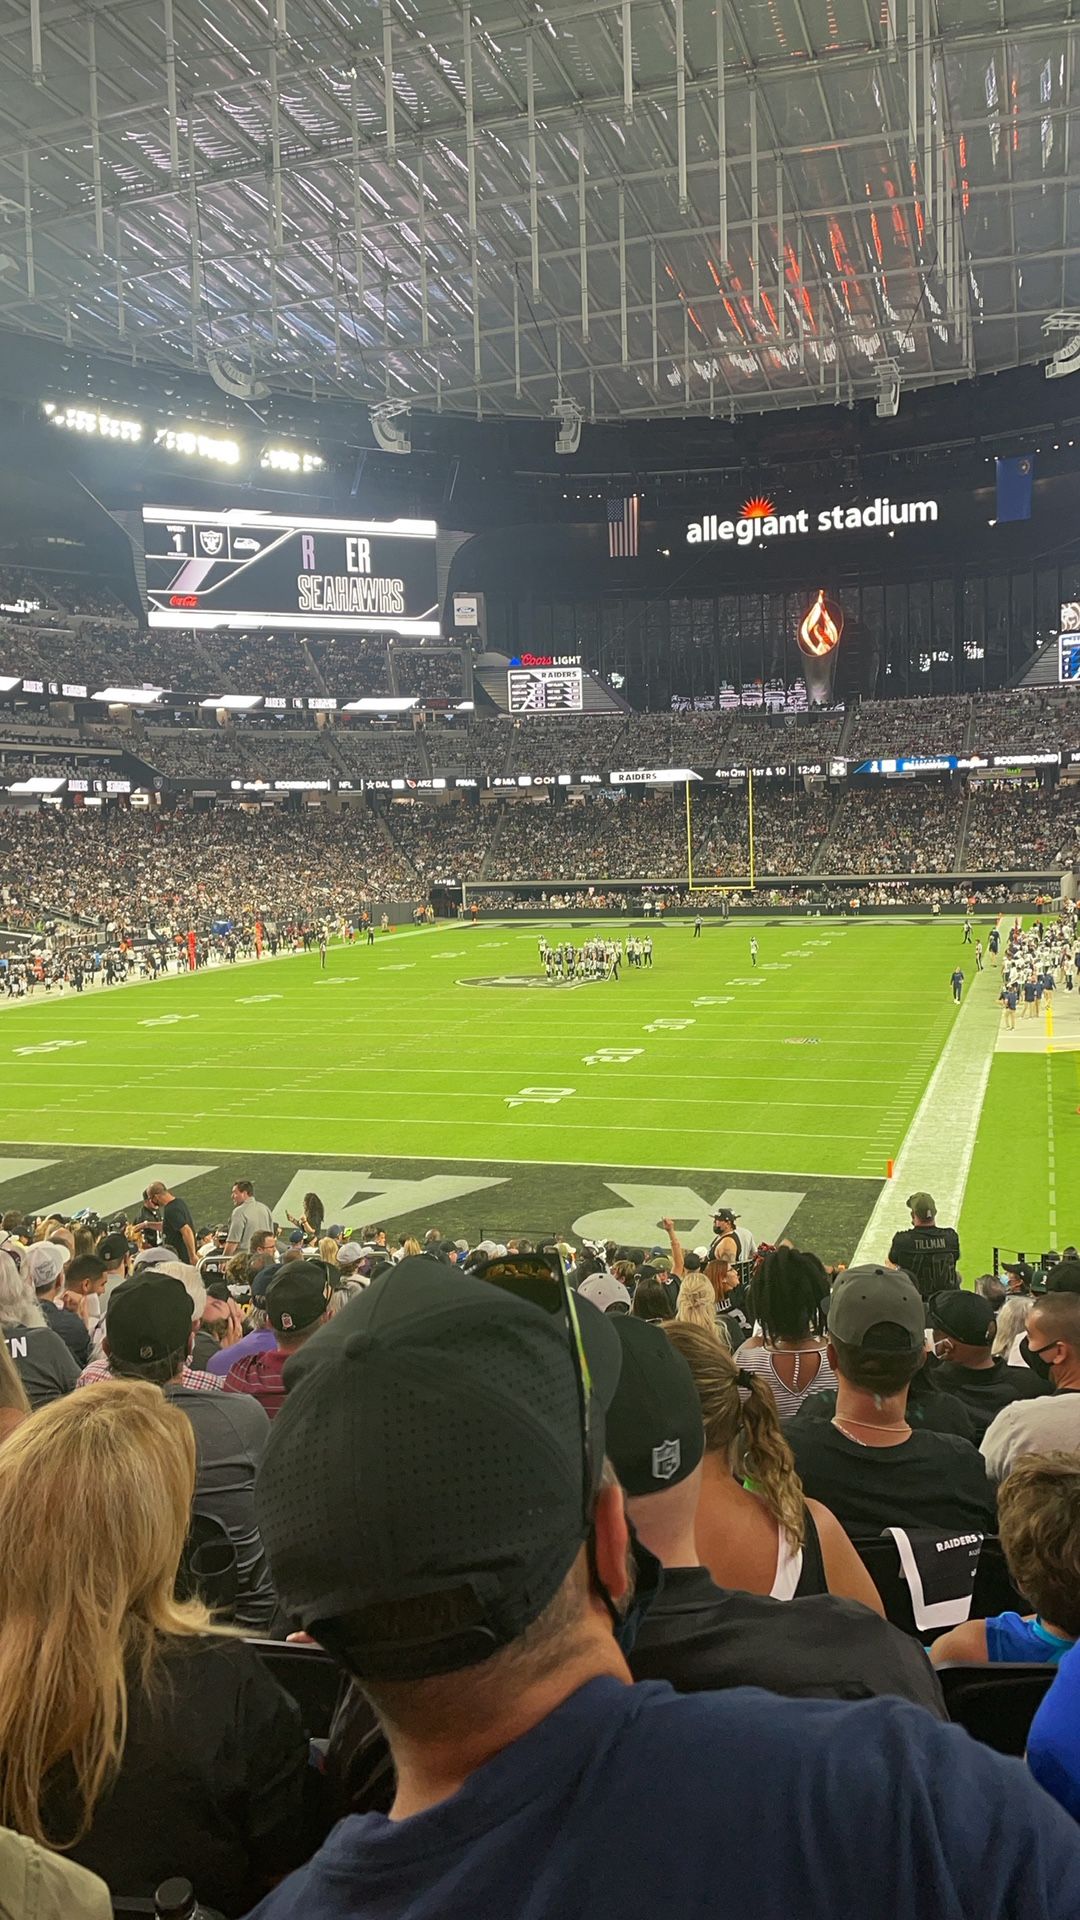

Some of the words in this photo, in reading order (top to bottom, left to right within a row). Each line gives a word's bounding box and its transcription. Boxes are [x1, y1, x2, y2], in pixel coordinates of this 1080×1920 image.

[686, 509, 809, 545] allegiant
[817, 498, 938, 530] stadium
[172, 533, 182, 552] 1
[298, 575, 404, 614] SEAHAWKS
[521, 654, 552, 666] Coors
[553, 655, 581, 665] LIGHT
[541, 670, 578, 679] RAIDERS
[993, 753, 1058, 765] SCOREBOARD
[775, 767, 787, 776] 10
[798, 765, 821, 775] 12:49
[455, 778, 477, 787] FINAL
[580, 775, 602, 784] FINAL
[618, 773, 657, 782] RAIDERS
[274, 780, 328, 790] SCOREBOARD
[338, 780, 353, 789] NFL
[375, 779, 390, 788] DAL
[416, 778, 432, 788] ARZ
[581, 1047, 645, 1066] 20
[503, 1087, 576, 1109] 10
[913, 1238, 946, 1250] TILLMAN
[936, 1534, 978, 1552] RAIDERS
